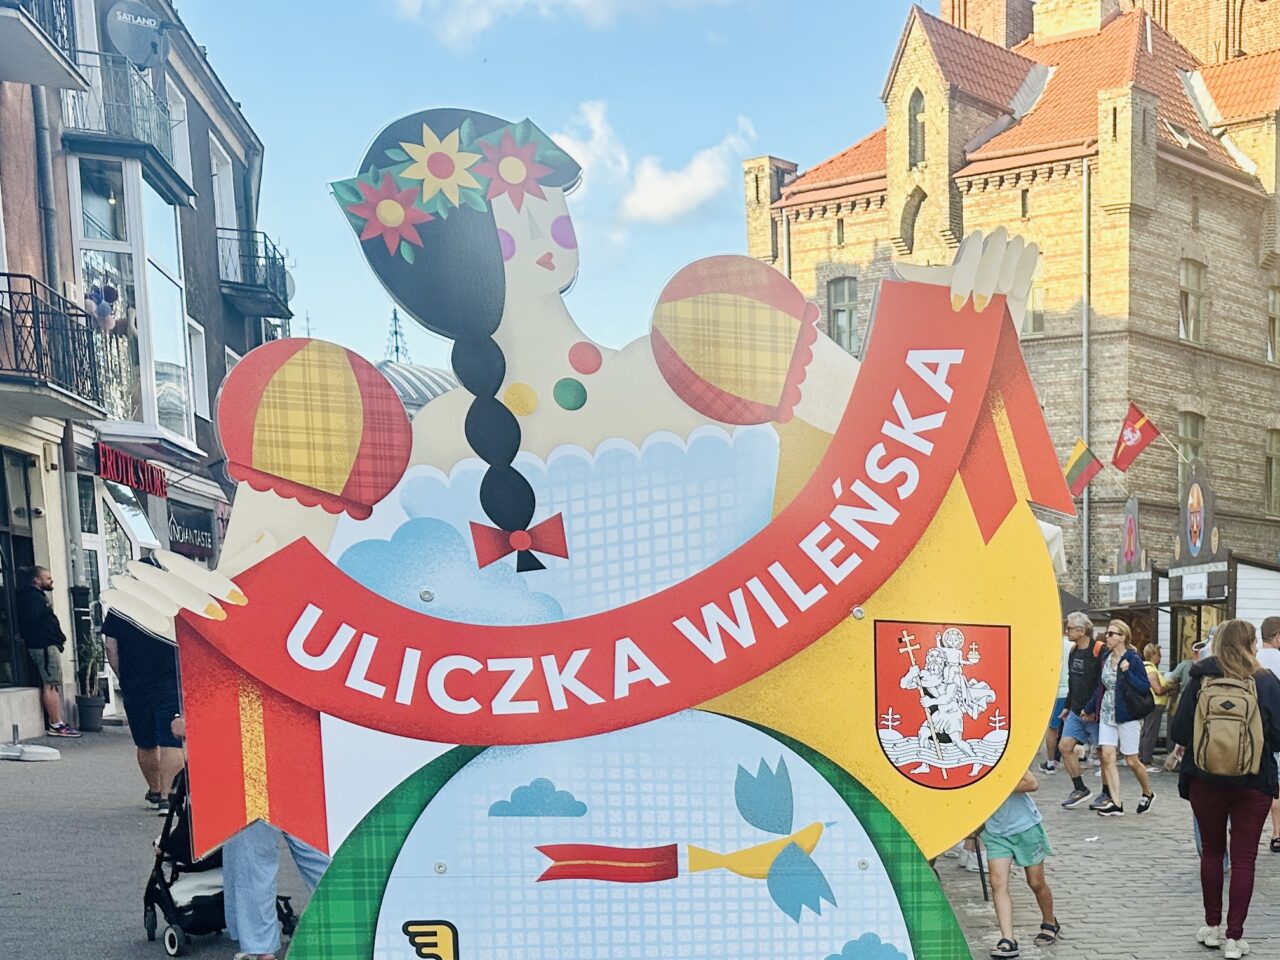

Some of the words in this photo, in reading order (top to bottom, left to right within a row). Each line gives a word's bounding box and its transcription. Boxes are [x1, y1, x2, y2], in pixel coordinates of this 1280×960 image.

[116, 11, 157, 27] SATLAND
[98, 442, 139, 489] EROTIC
[138, 460, 168, 499] STORE
[285, 602, 671, 716] ULICZKA
[672, 347, 966, 665] WILEŃSKA
